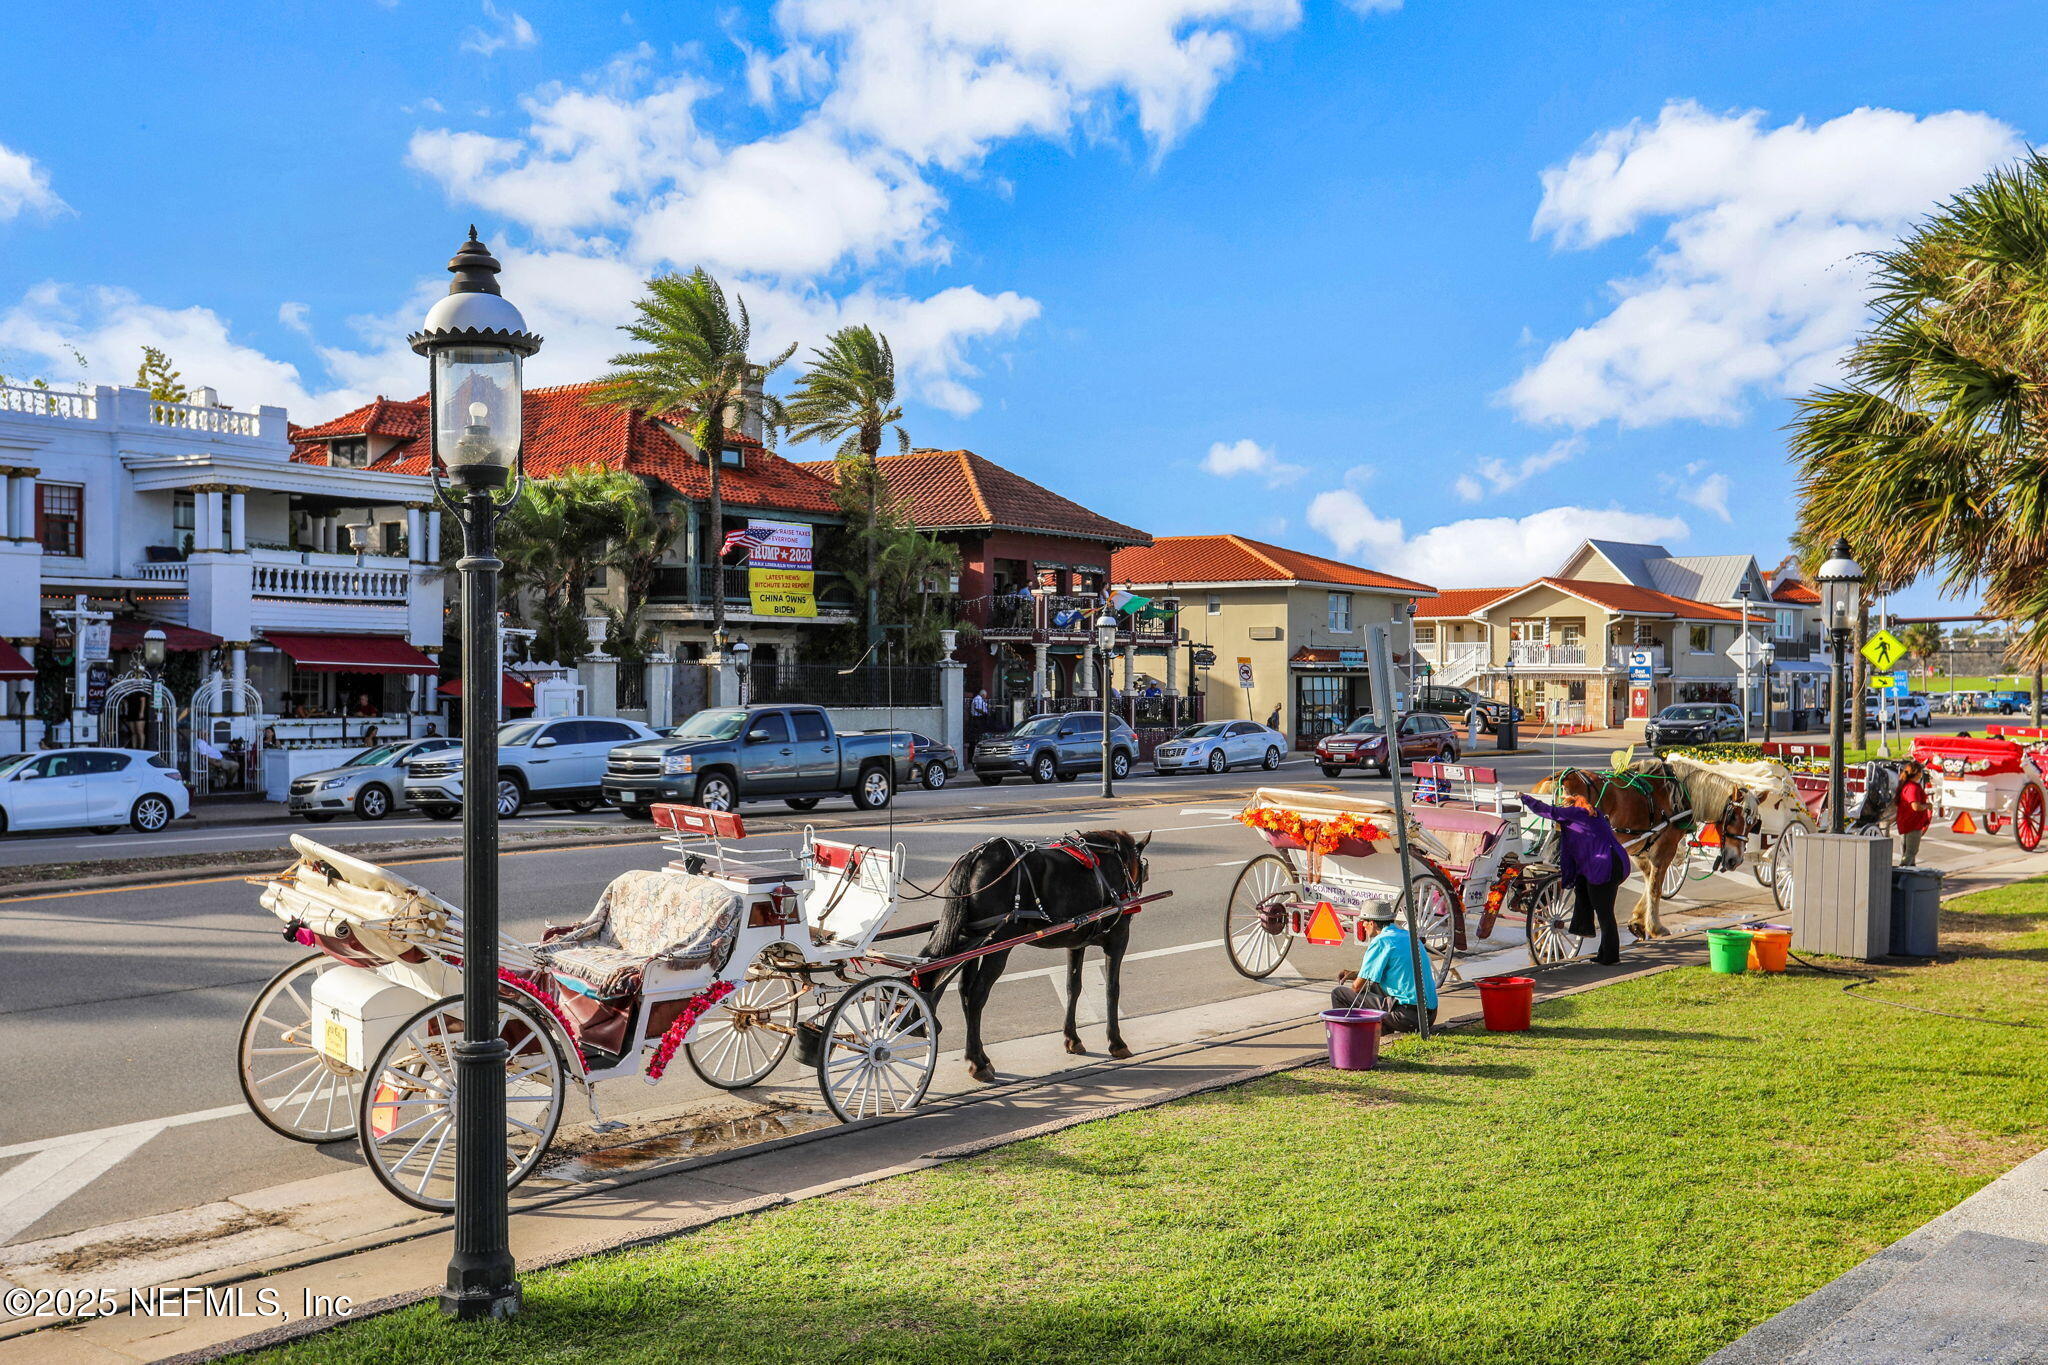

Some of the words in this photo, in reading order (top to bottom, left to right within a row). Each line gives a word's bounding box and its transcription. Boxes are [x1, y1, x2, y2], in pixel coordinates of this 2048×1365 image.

[749, 545, 780, 560] TRUMP
[789, 548, 812, 562] 2020
[760, 594, 783, 602] CHINA
[785, 595, 806, 604] OWNS
[774, 605, 796, 614] BIDEN
[56, 638, 70, 647] INN
[1312, 884, 1346, 896] COUNTRY
